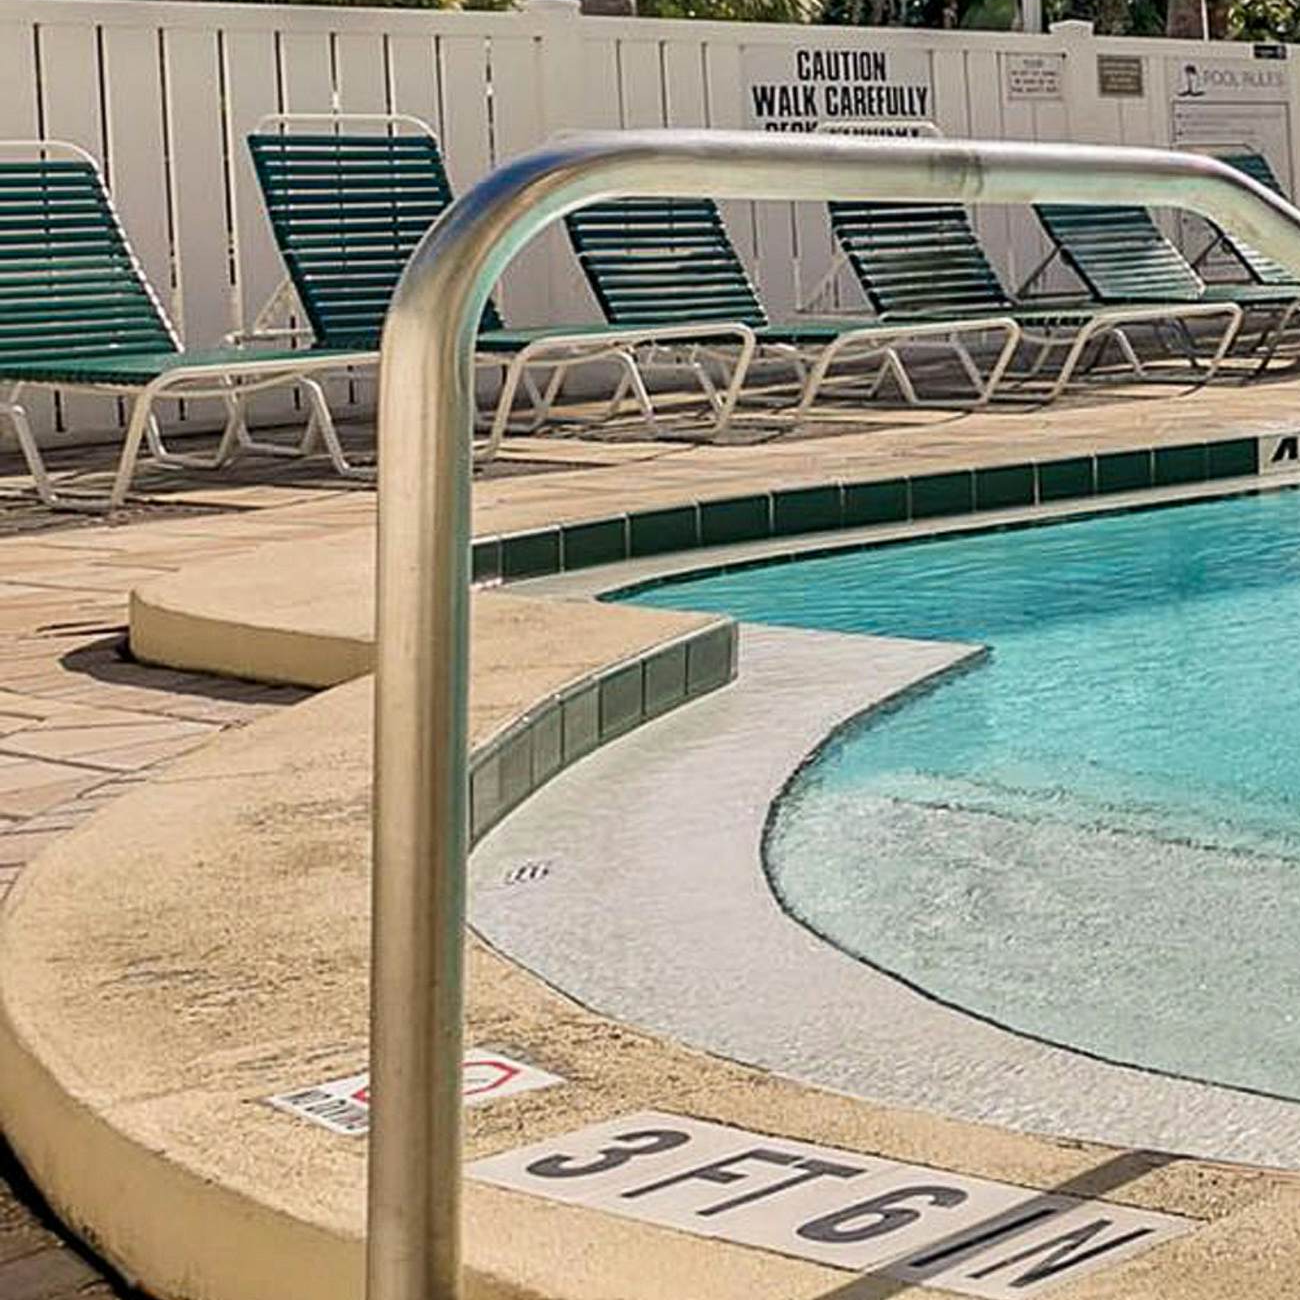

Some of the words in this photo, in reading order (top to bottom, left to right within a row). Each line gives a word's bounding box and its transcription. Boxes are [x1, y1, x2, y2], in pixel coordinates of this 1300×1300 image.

[797, 50, 886, 81] CAUTION
[752, 85, 817, 117] WALK
[825, 85, 927, 117] CAREFULLY
[525, 1128, 690, 1179] 3
[620, 1148, 869, 1218] FT
[795, 1184, 969, 1245] 6
[905, 1207, 1155, 1288] IN
